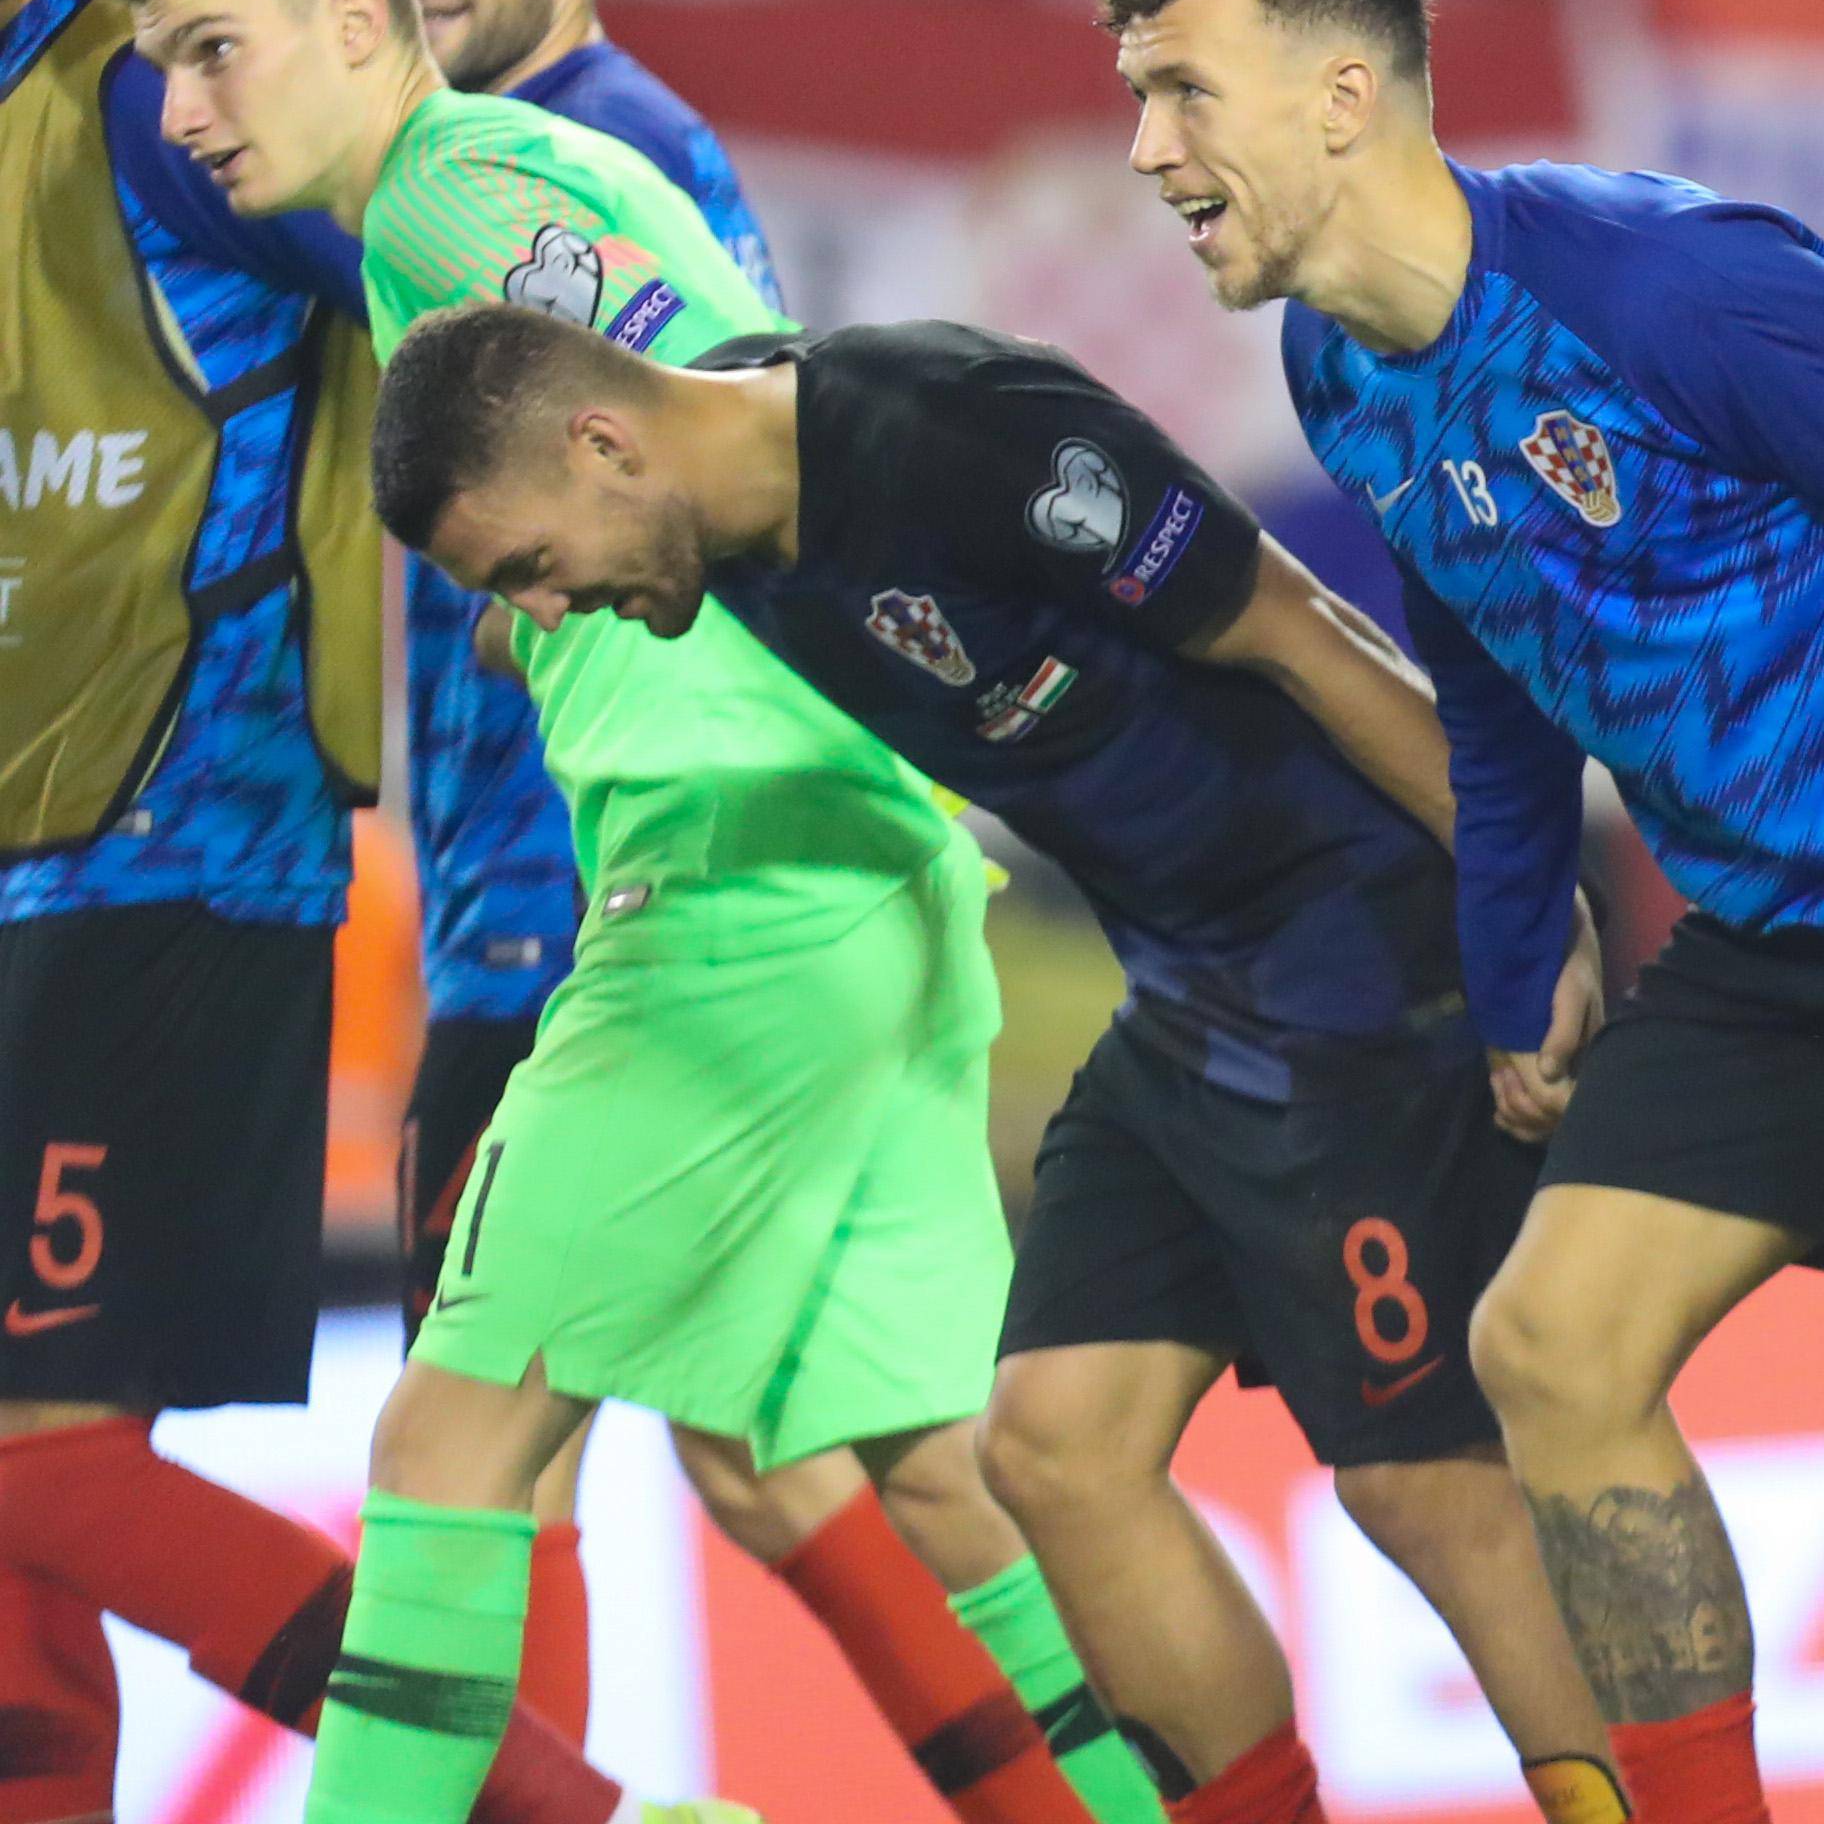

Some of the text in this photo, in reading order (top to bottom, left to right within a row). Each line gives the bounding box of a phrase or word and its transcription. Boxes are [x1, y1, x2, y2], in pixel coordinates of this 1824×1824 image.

[0, 427, 149, 512] AME
[1442, 459, 1498, 527] 13
[1133, 489, 1194, 582] RESPECT
[29, 1142, 107, 1288] 5
[1342, 1216, 1429, 1363] 8
